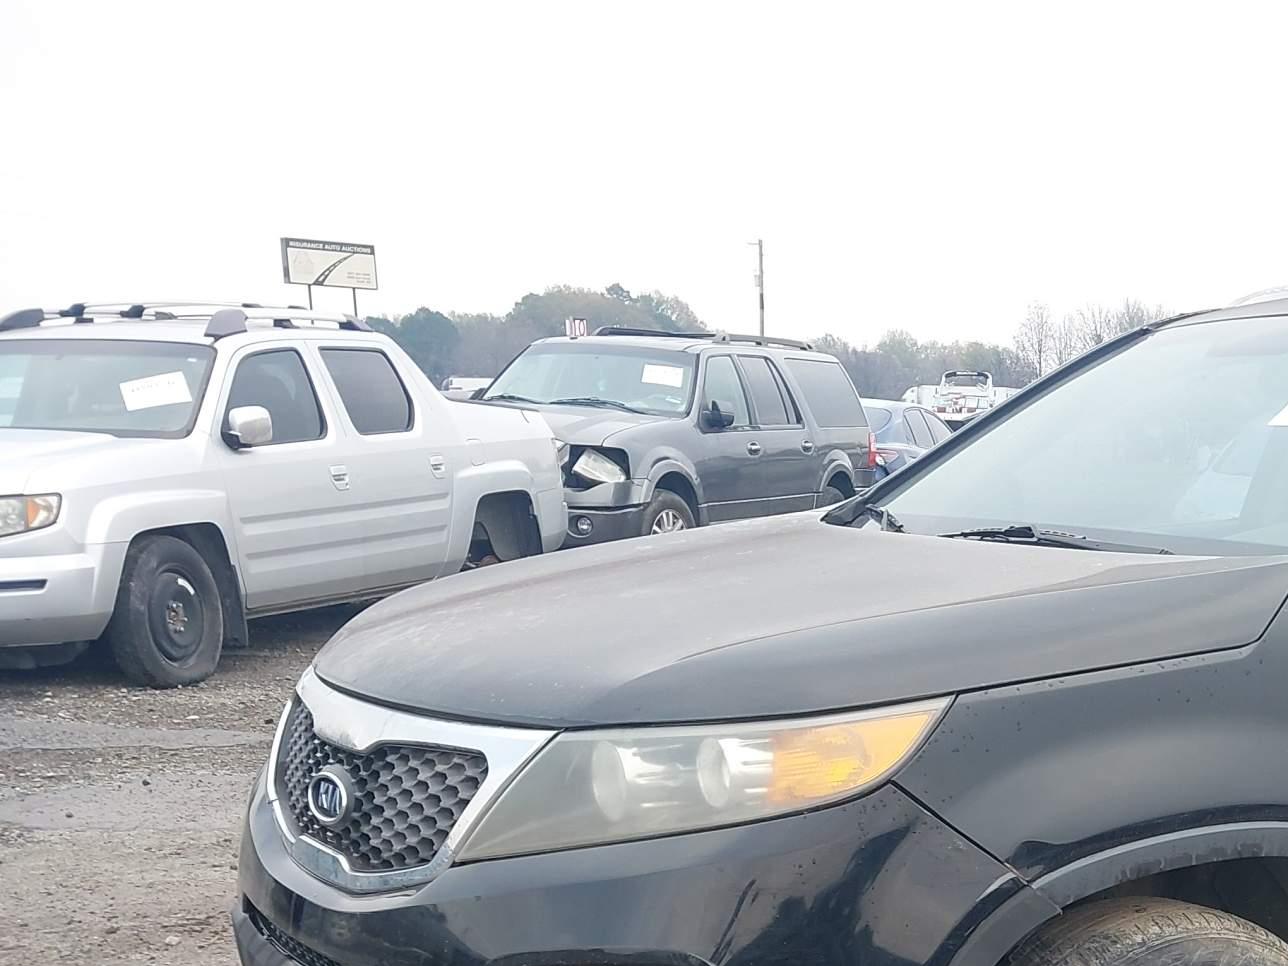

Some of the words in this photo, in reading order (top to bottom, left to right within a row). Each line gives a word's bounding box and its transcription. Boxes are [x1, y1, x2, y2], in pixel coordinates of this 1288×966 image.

[289, 240, 323, 250] INSURANCE
[325, 243, 340, 252] AUTO
[342, 245, 371, 254] AUCTIONS
